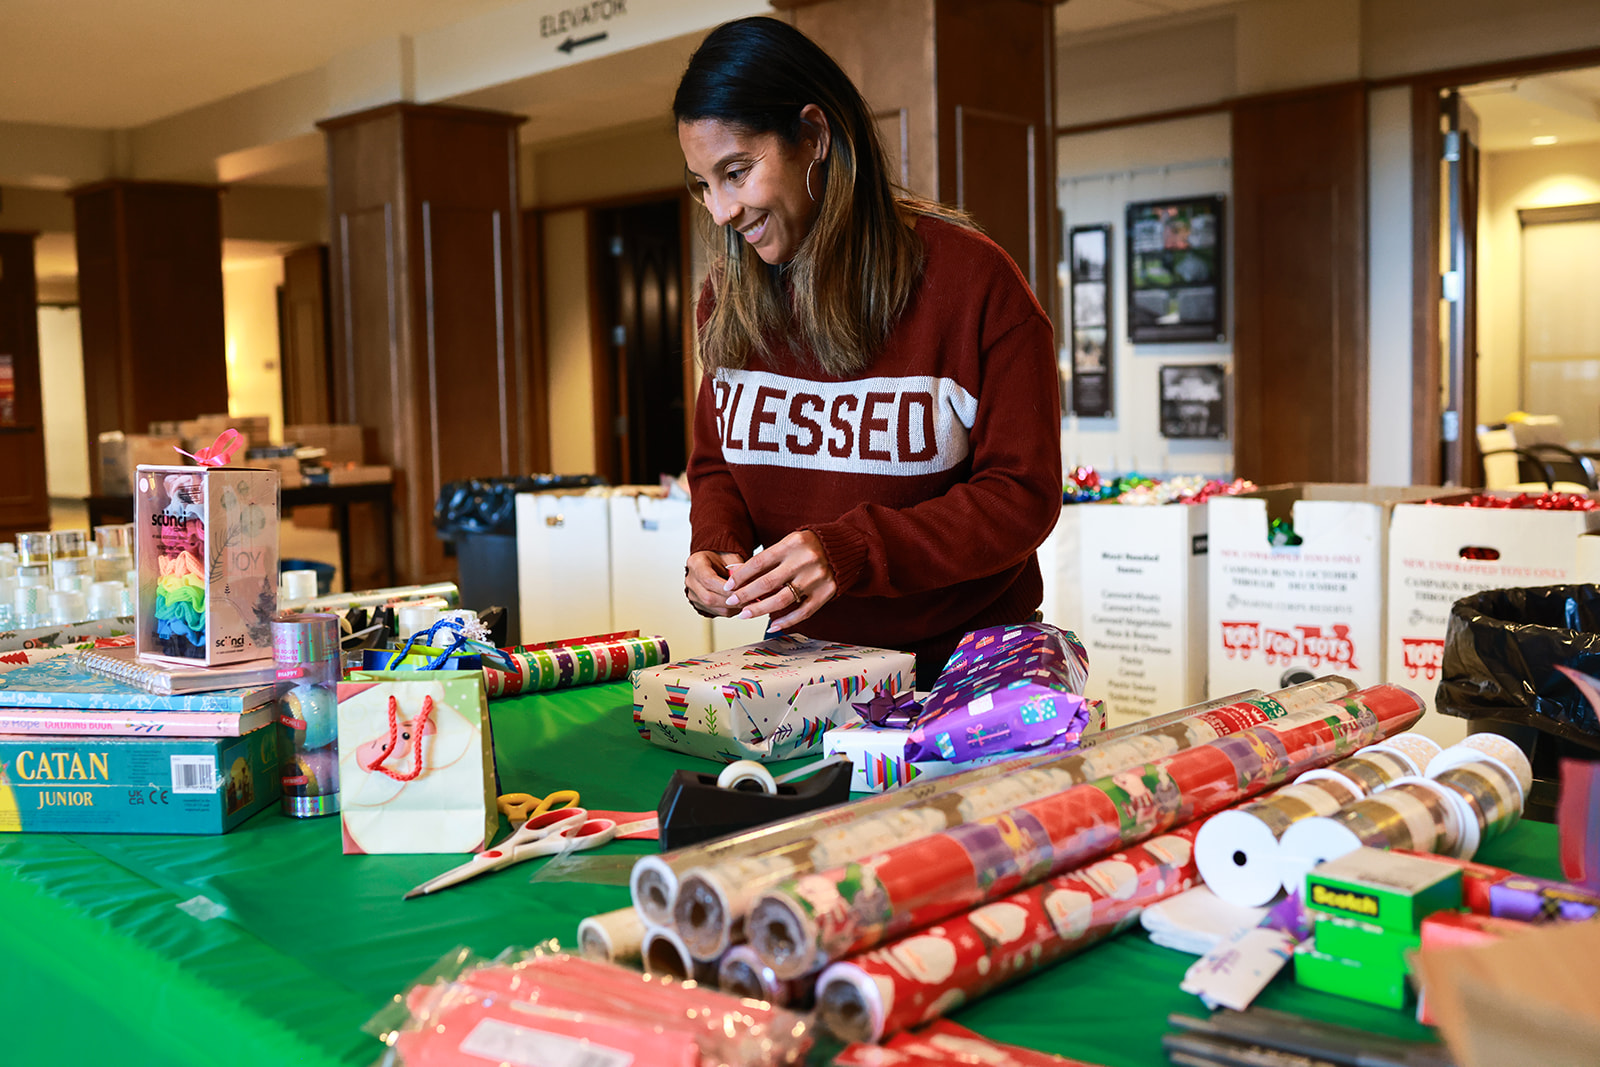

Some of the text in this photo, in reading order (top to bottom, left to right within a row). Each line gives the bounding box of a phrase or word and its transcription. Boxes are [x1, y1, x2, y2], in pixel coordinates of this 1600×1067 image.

[540, 0, 627, 37] ELEVATOR
[151, 510, 187, 527] scünci
[230, 551, 261, 573] JOY
[216, 634, 245, 647] scünci
[16, 750, 109, 780] CATAN
[37, 791, 94, 809] JUNIOR
[1313, 885, 1378, 916] Scotch
